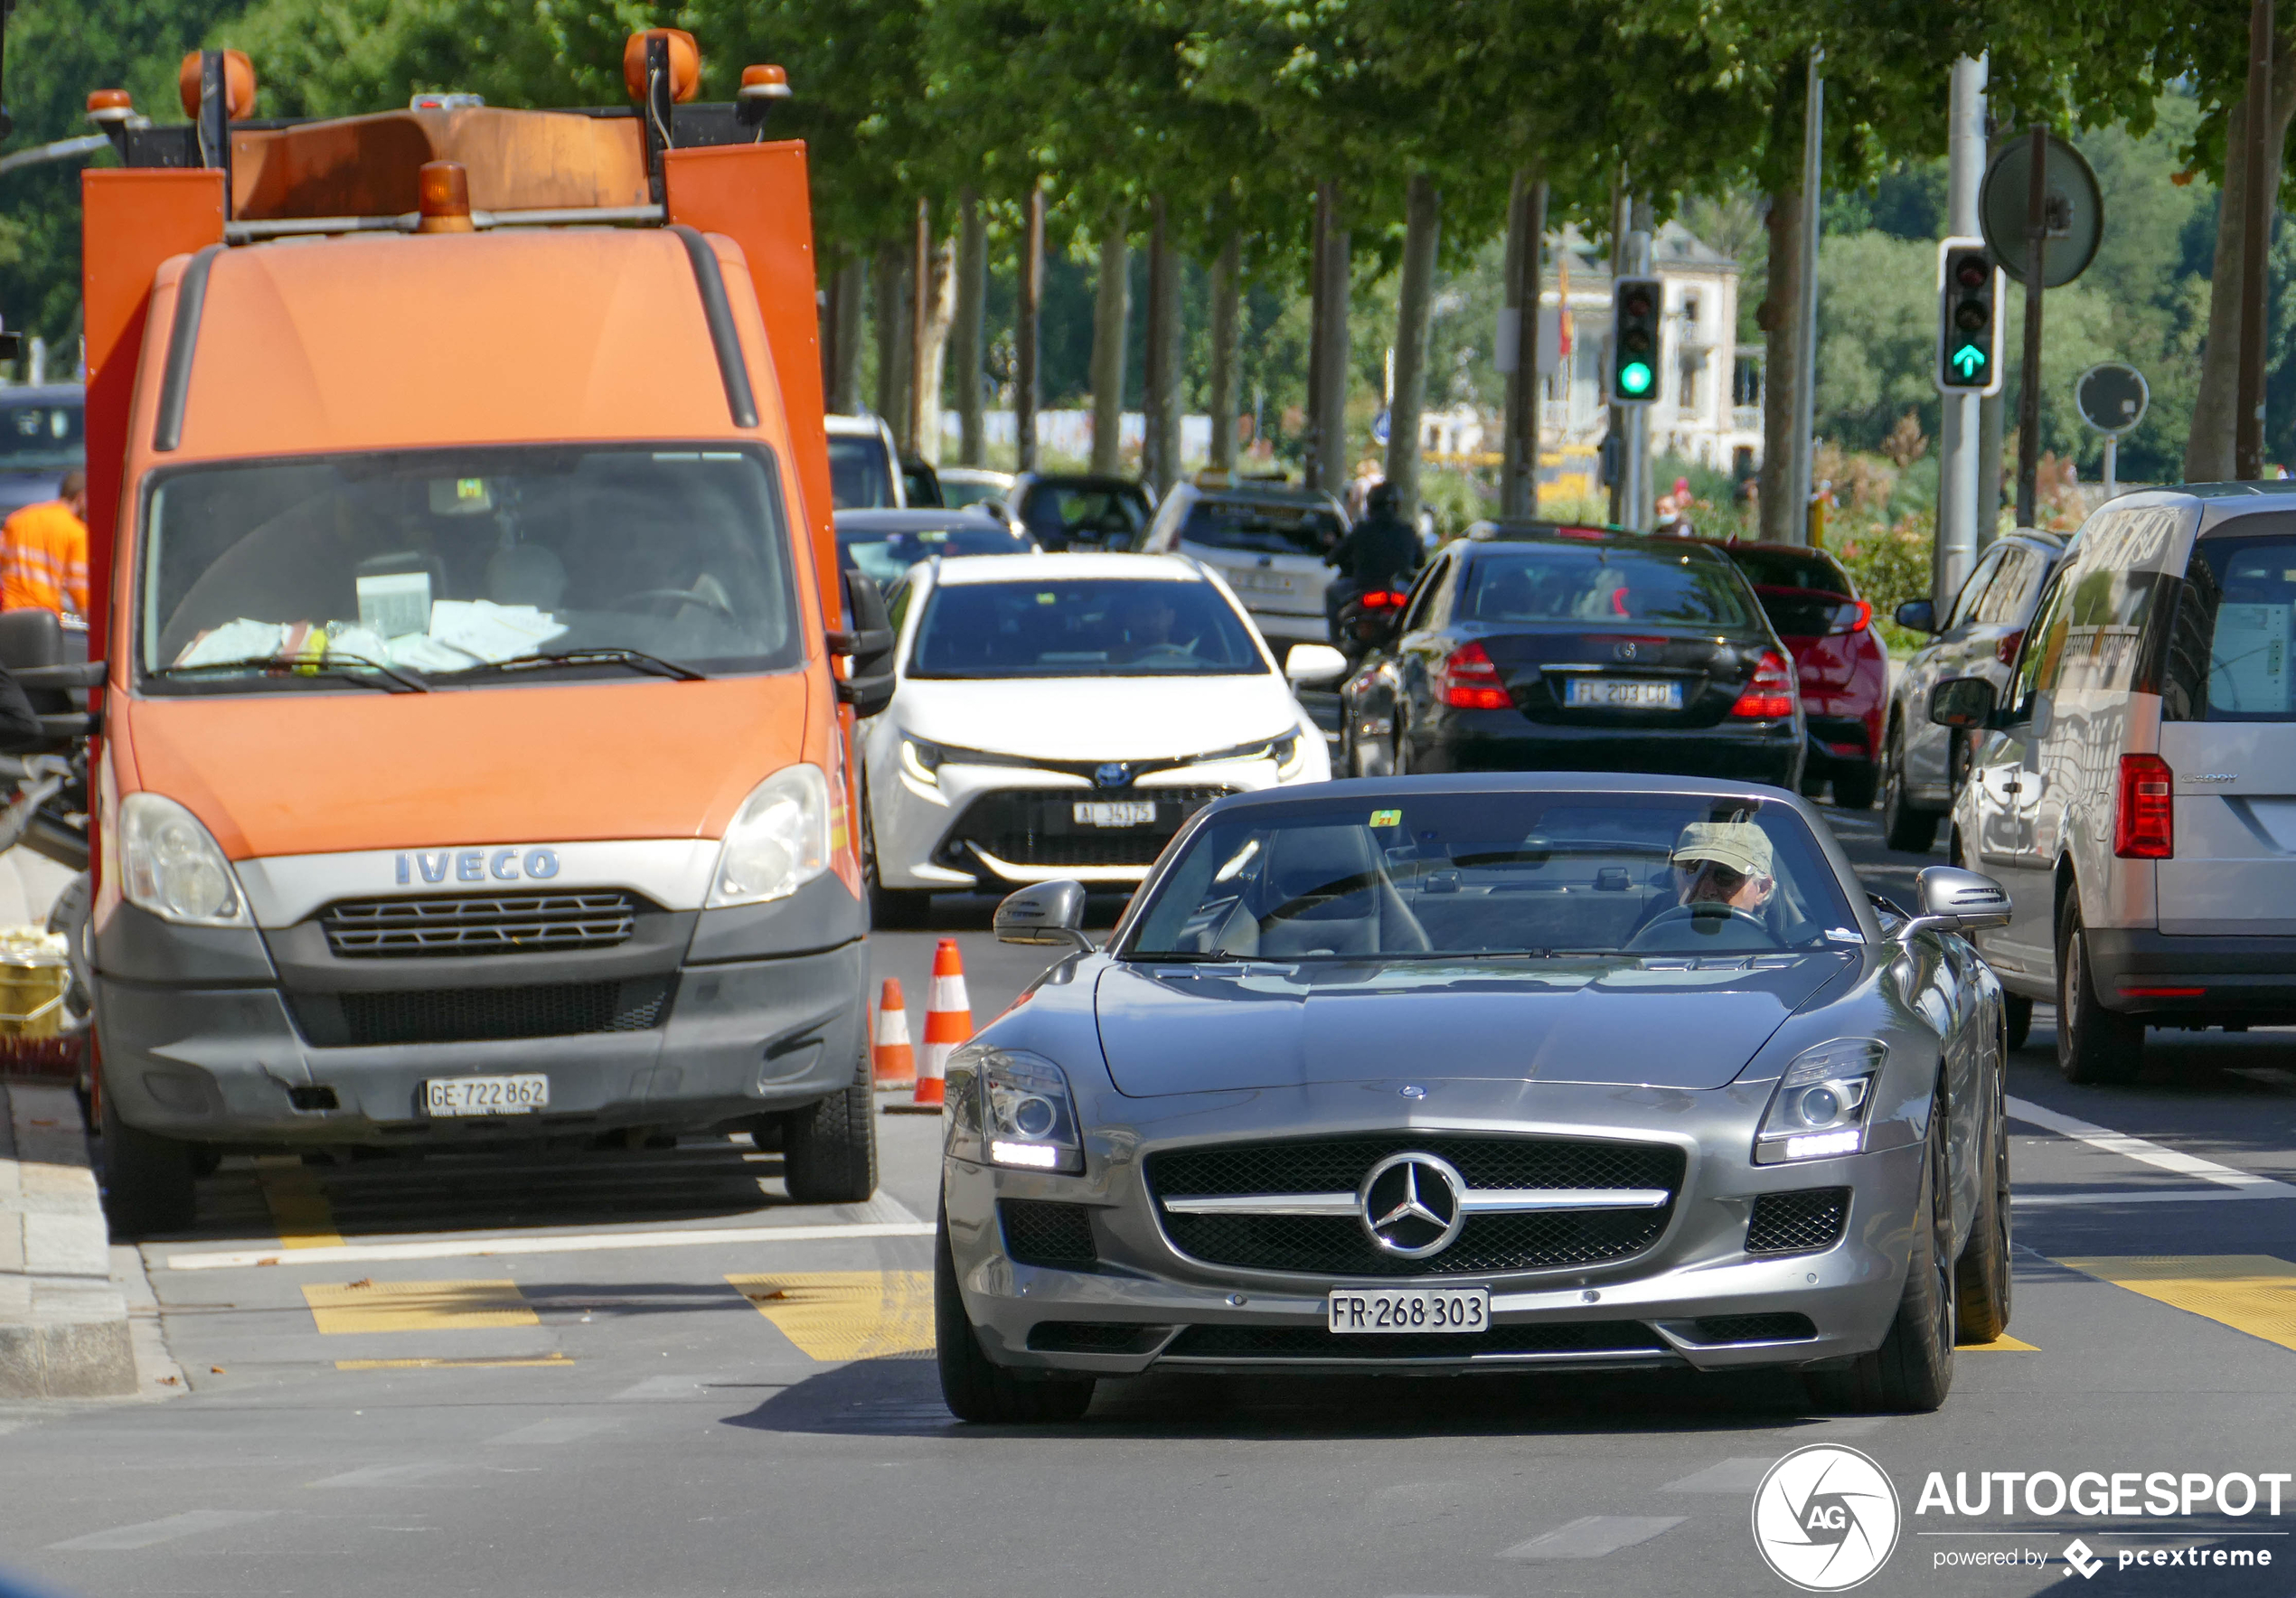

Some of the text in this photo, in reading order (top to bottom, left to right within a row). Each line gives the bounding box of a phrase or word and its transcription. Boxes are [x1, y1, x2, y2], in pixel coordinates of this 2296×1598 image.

[2181, 773, 2239, 784] CADDY
[1379, 817, 1392, 825] 21
[396, 849, 560, 885] IVECO
